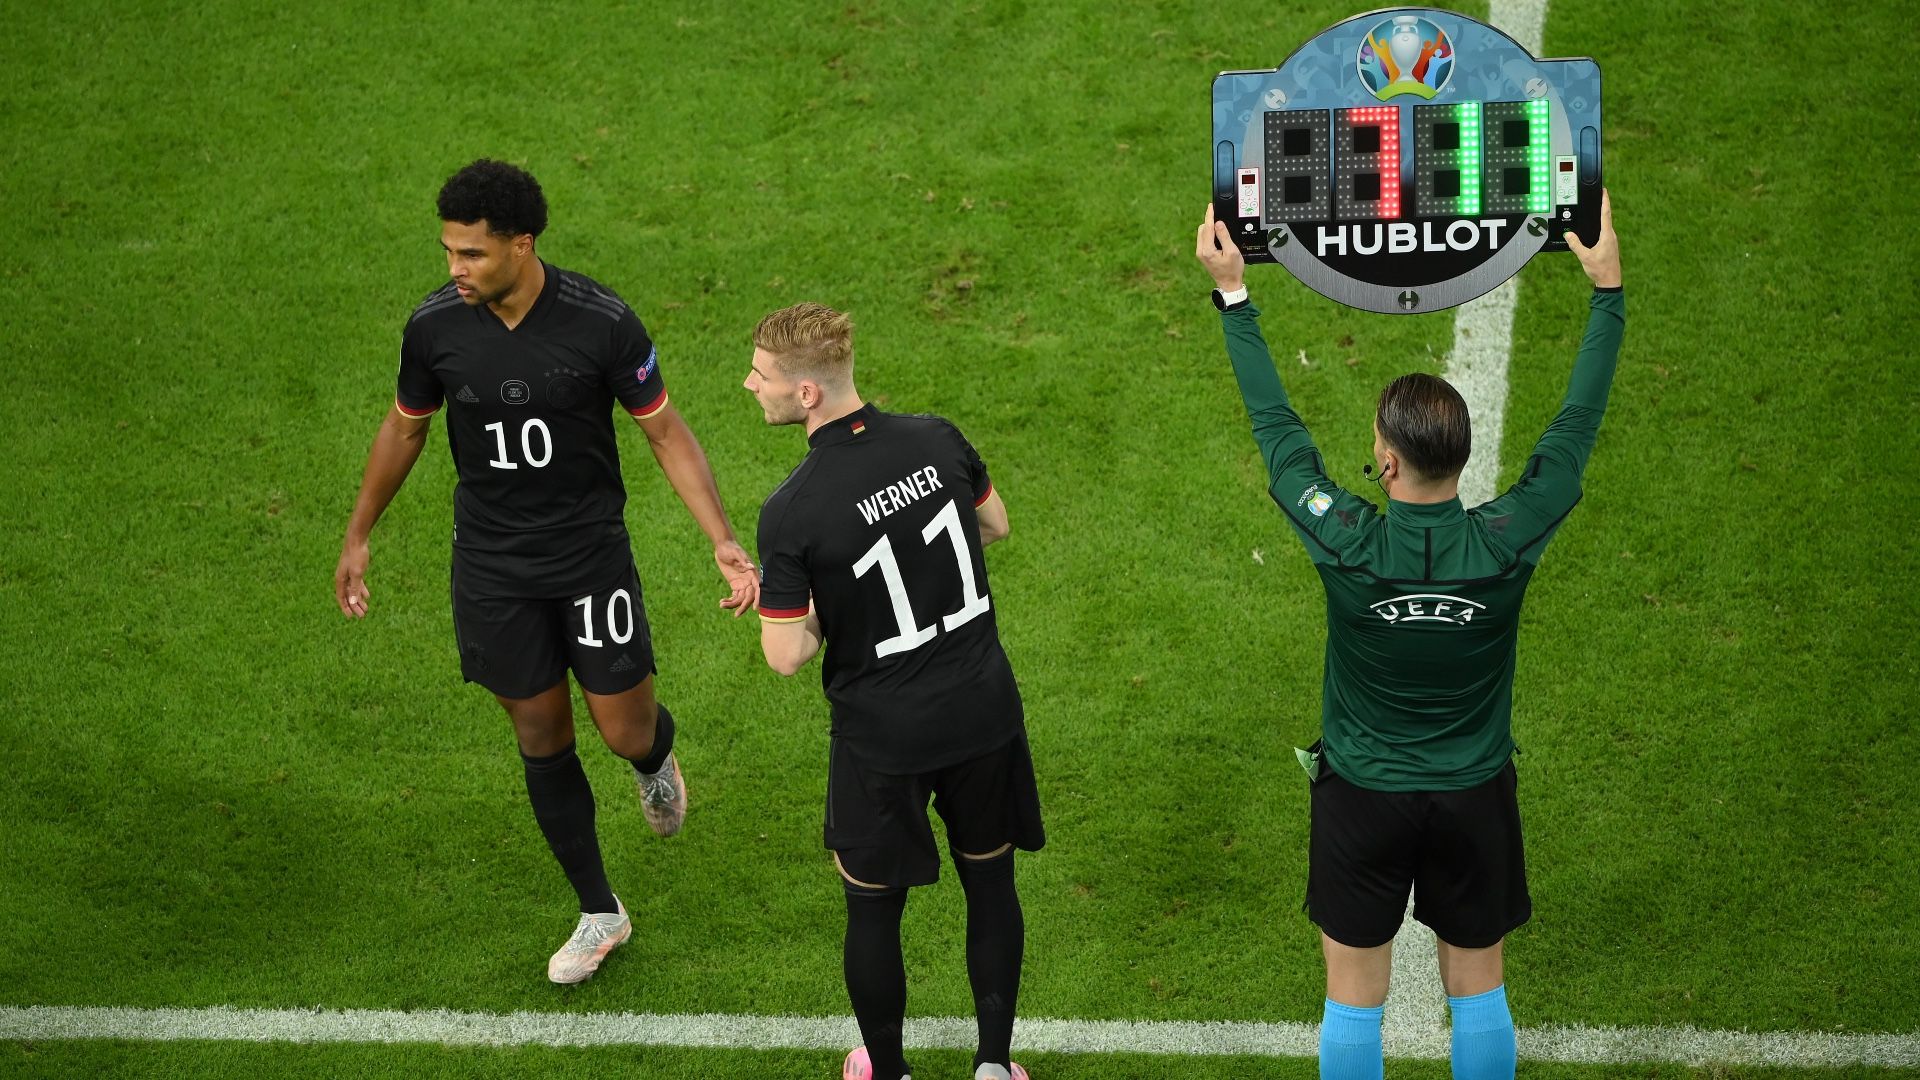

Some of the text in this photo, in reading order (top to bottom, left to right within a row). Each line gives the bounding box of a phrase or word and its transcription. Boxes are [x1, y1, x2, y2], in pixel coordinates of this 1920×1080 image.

[1350, 100, 1549, 218] 7 11
[1316, 218, 1507, 257] HUBLOT
[484, 417, 553, 470] 10
[856, 465, 944, 526] WERNER
[851, 498, 990, 659] 11
[573, 588, 634, 648] 10
[1375, 600, 1475, 622] UEFA
